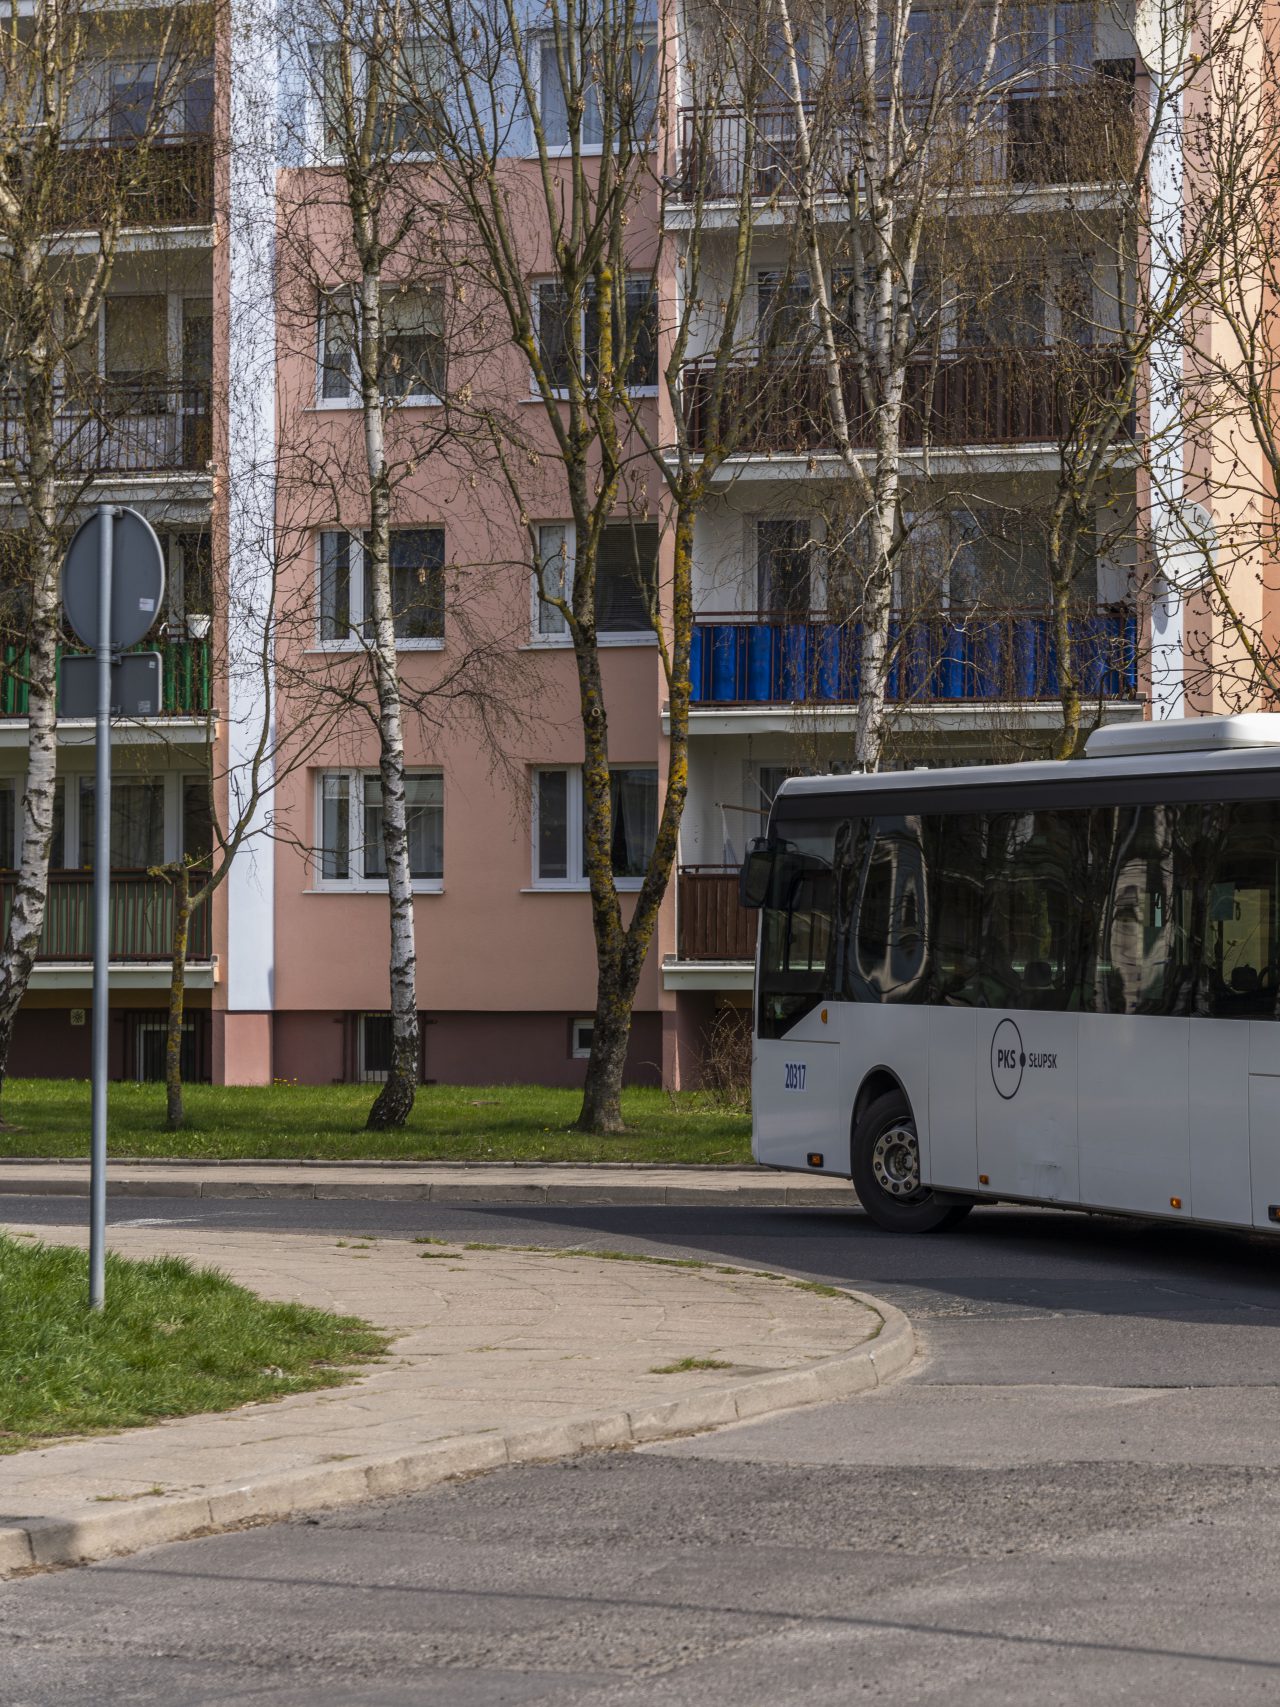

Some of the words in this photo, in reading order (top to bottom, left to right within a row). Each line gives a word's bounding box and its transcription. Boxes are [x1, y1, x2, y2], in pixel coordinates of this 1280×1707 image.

[997, 1049, 1016, 1069] PKS
[1028, 1052, 1058, 1069] SŁUPSK
[785, 1063, 807, 1090] 20317
